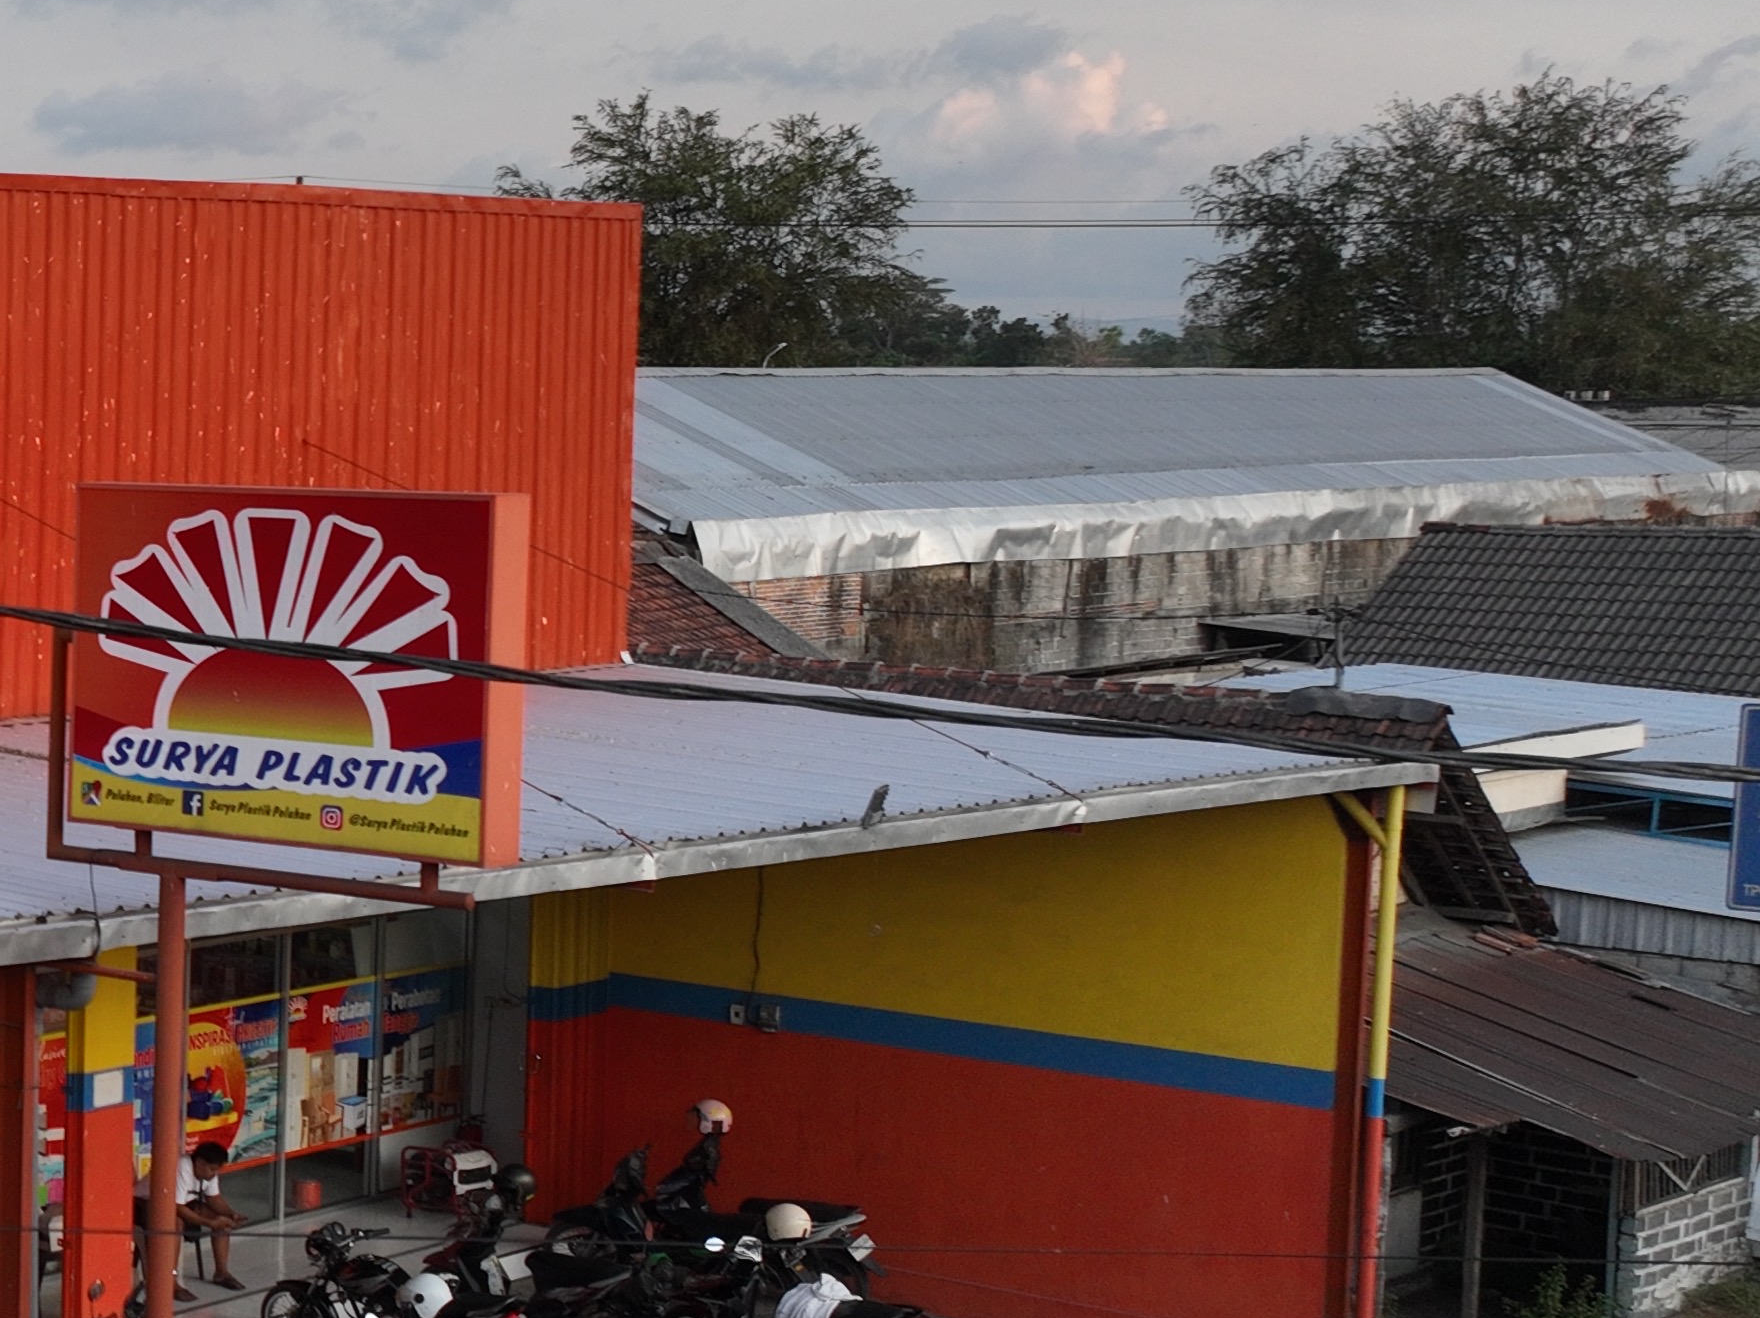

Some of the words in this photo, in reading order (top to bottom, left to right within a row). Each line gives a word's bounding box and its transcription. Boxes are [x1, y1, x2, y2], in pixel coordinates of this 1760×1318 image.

[108, 736, 239, 778] SURYA
[255, 750, 439, 797] PLASTIK
[209, 799, 236, 815] Surya
[237, 801, 271, 816] Plastik
